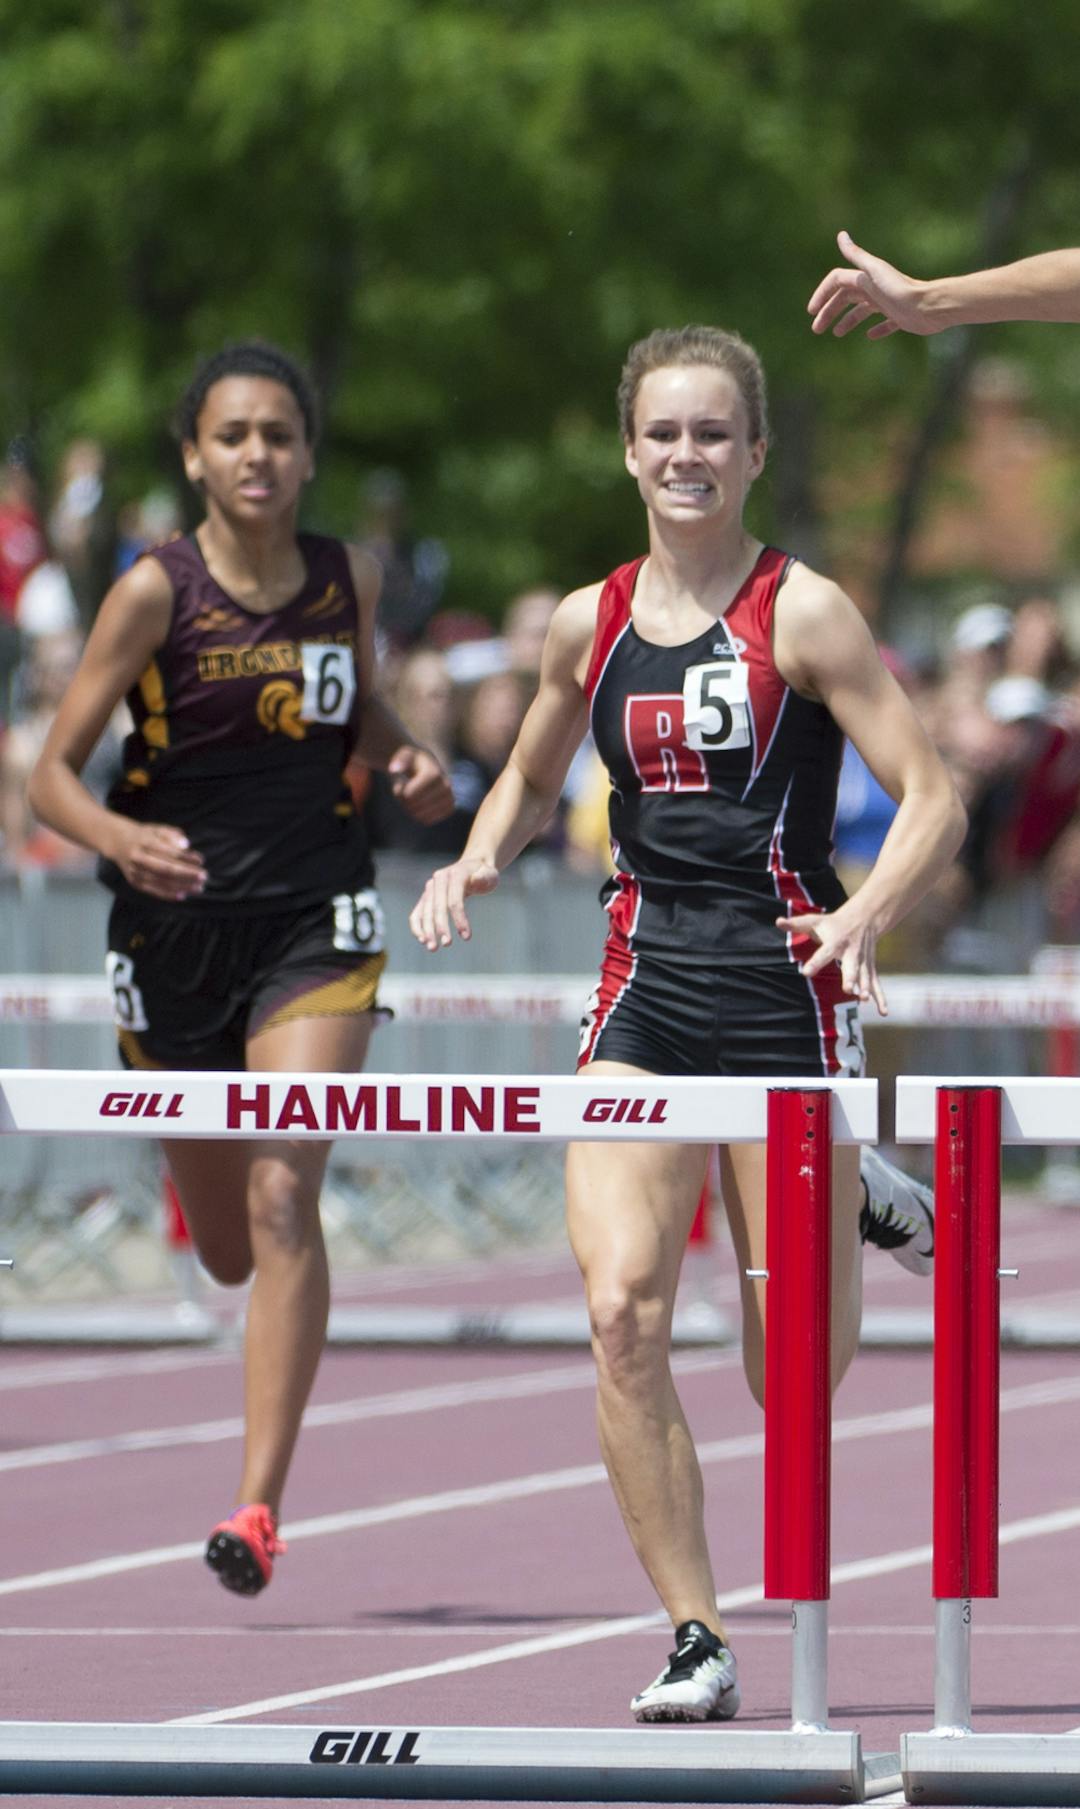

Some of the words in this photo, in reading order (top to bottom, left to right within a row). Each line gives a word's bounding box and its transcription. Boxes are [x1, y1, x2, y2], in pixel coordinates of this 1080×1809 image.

[317, 652, 343, 716] 6
[700, 669, 733, 746] 5
[624, 692, 713, 793] R
[350, 898, 375, 944] 6
[100, 1092, 184, 1118] GILL
[226, 1083, 541, 1133] HAMLINE
[582, 1098, 668, 1124] GILL
[309, 1731, 421, 1765] GILL
